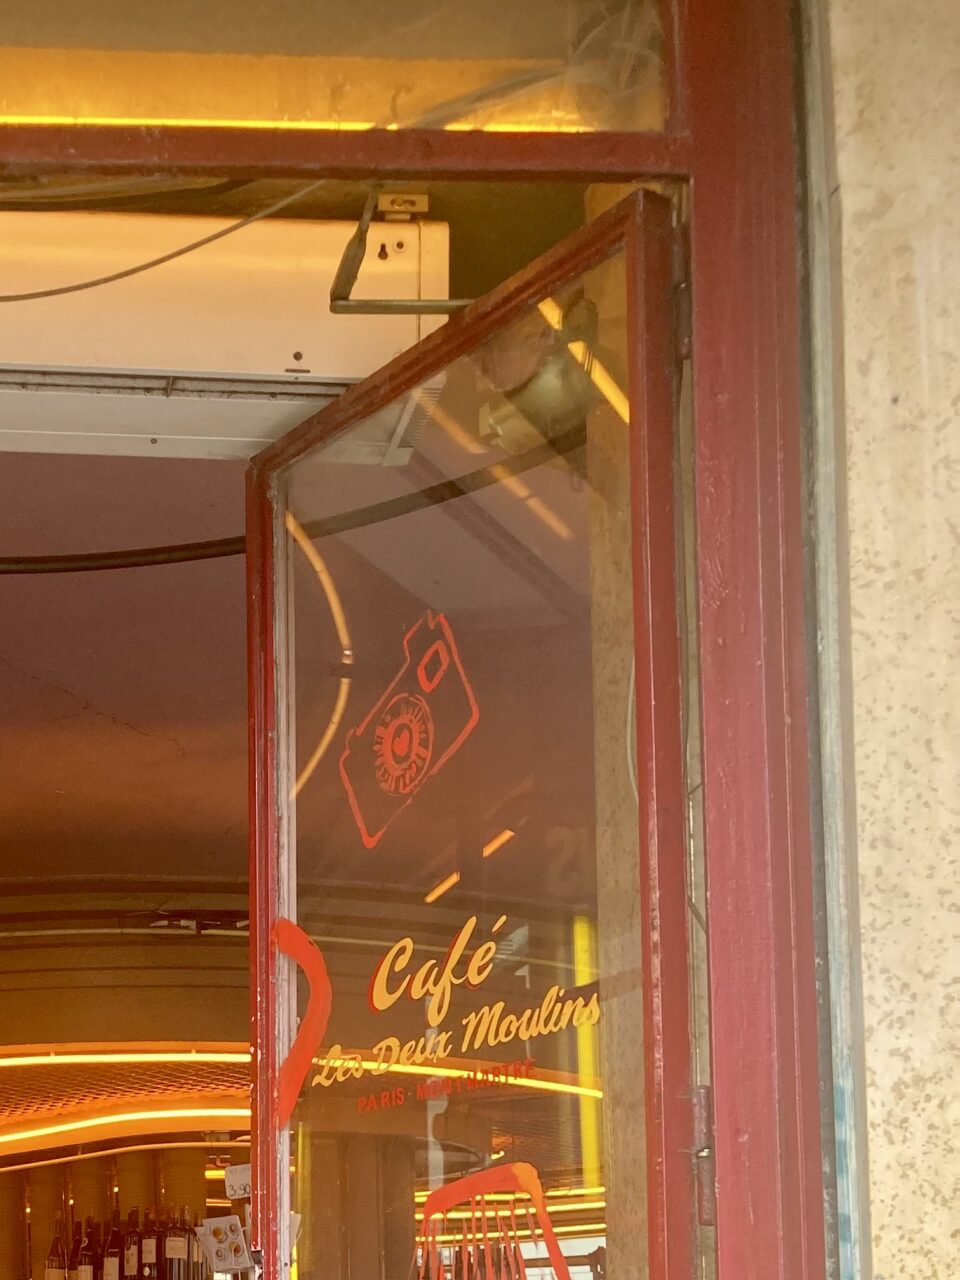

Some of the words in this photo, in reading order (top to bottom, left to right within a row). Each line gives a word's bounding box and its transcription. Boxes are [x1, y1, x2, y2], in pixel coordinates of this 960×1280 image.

[368, 914, 508, 1027] Café
[311, 1044, 363, 1088] Les
[371, 1029, 454, 1076] Deux
[461, 984, 601, 1053] Moulins
[356, 1086, 406, 1115] PARIS
